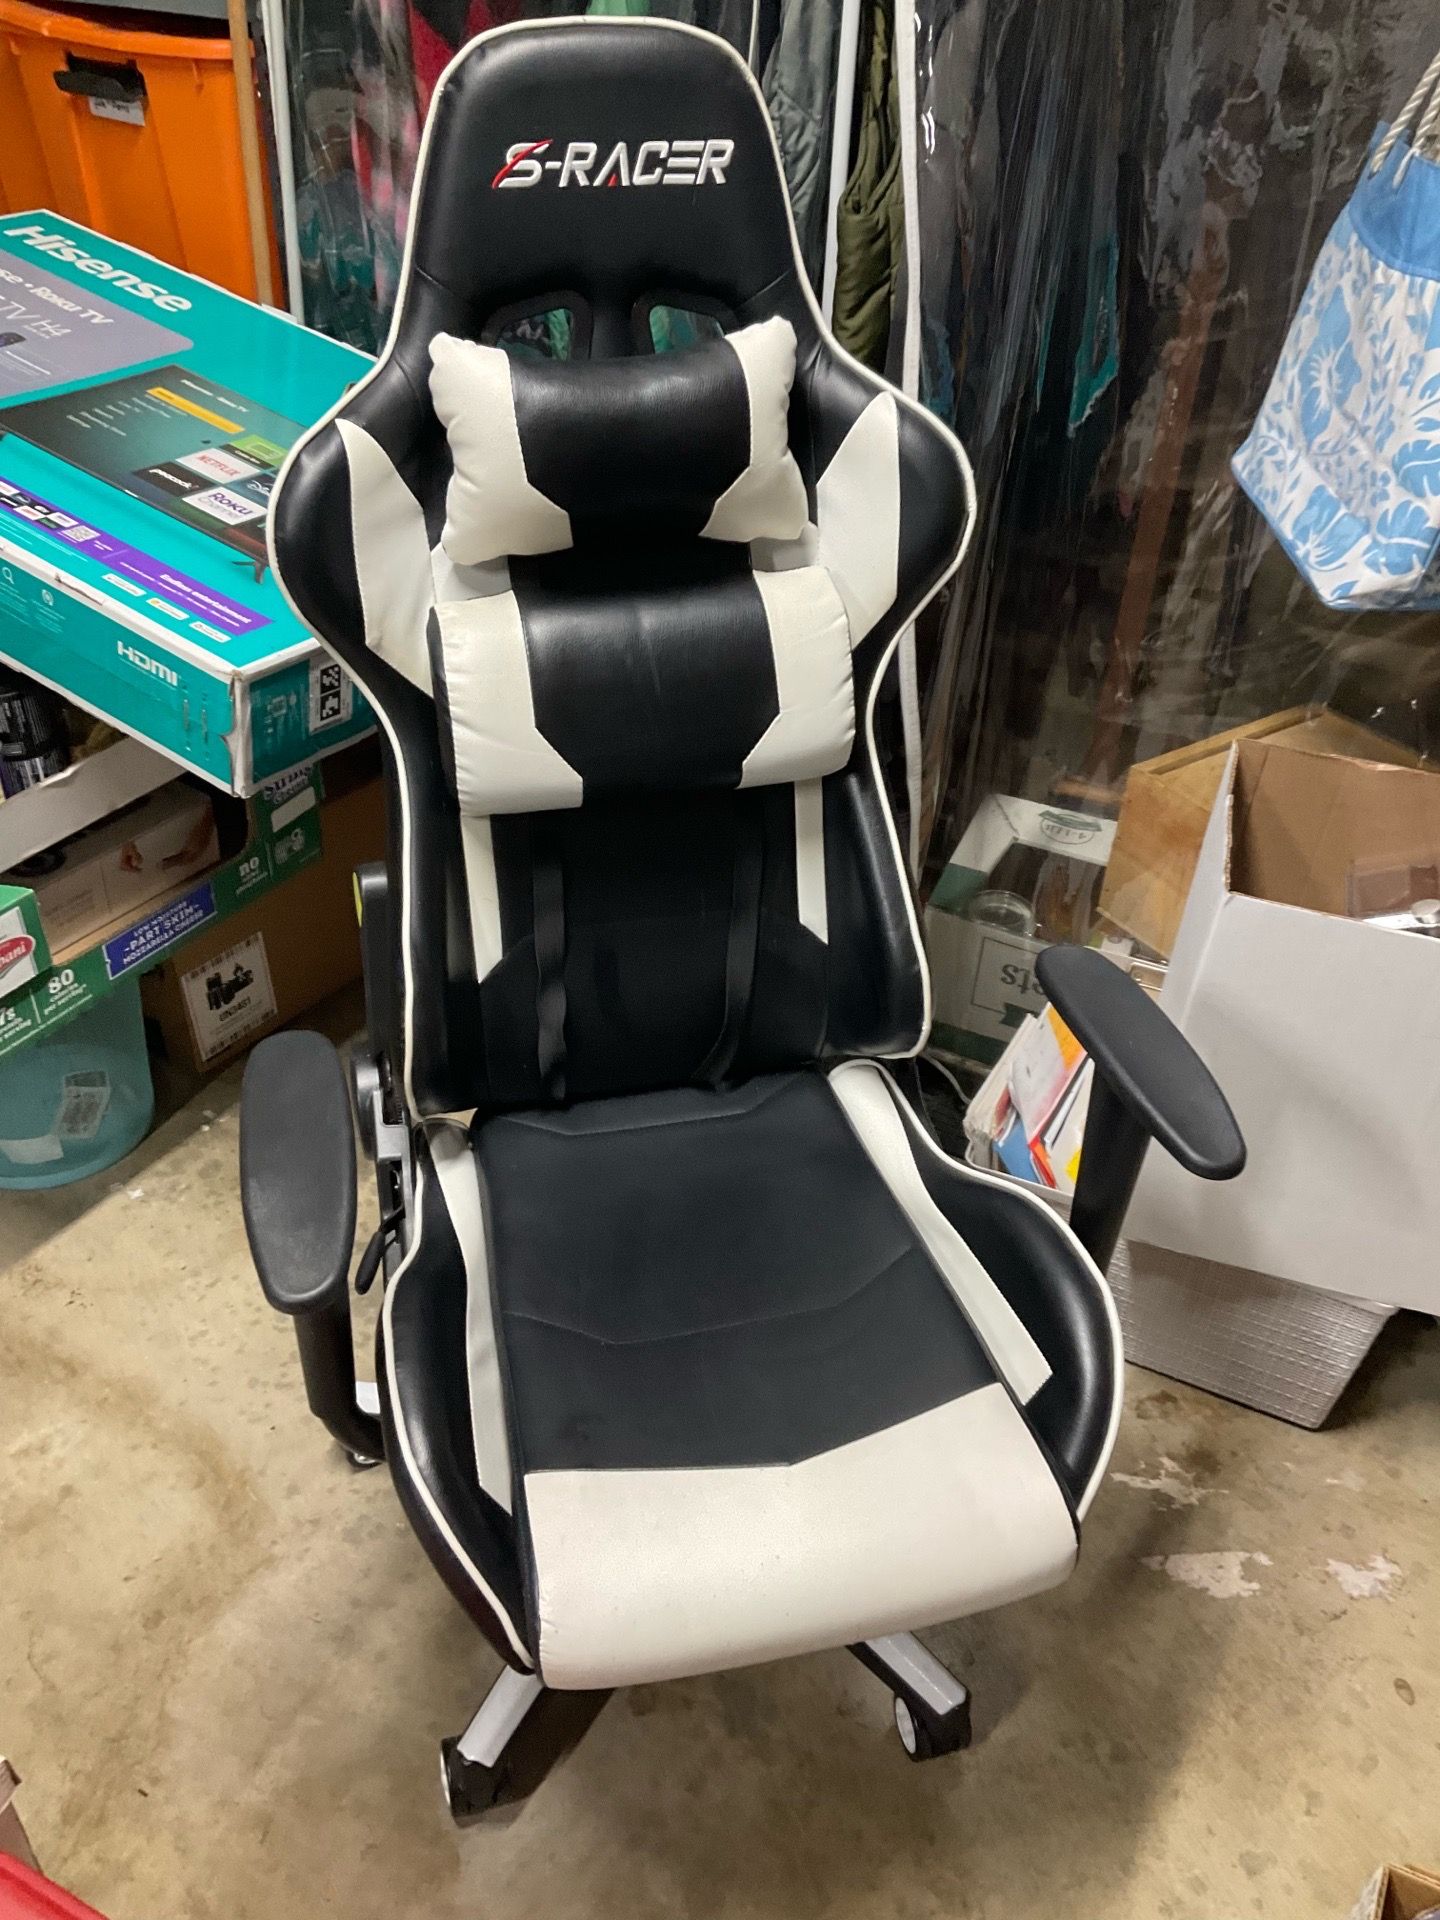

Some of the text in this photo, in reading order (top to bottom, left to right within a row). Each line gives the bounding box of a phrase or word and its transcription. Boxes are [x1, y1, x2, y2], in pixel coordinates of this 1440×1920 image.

[491, 138, 735, 189] S-RACER
[4, 225, 192, 313] Hisense
[117, 640, 179, 687] HDMI
[47, 968, 75, 994] 80
